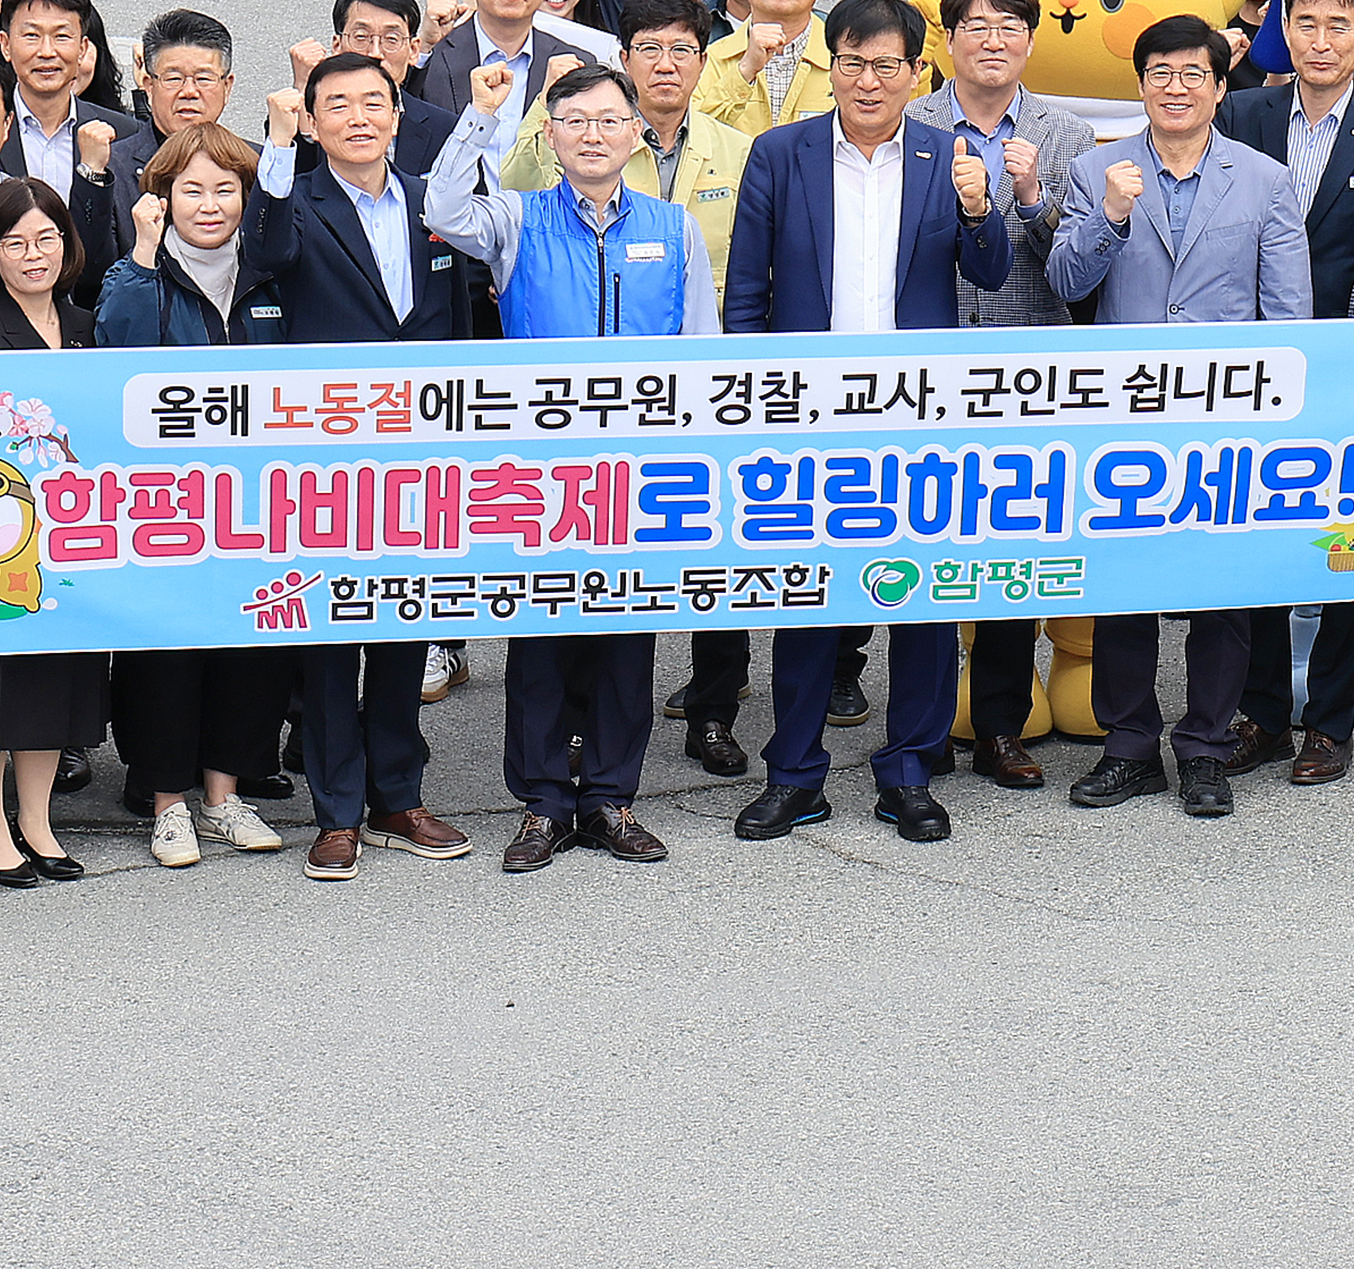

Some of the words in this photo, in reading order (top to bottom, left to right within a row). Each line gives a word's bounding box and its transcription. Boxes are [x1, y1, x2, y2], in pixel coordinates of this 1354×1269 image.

[150, 382, 251, 438] 올해
[263, 379, 520, 436] 노동절에는
[528, 372, 693, 430] 공무원,
[708, 370, 820, 426] 경찰,
[833, 367, 947, 421] 교사,
[960, 364, 1109, 419] 군인도
[1121, 359, 1283, 414] 쉽니다.
[42, 460, 714, 563] 함평나비대축제로
[737, 448, 1067, 541] 힐링하러
[329, 564, 831, 624] 함평군공무원노동조합
[931, 557, 1084, 603] 함평군
